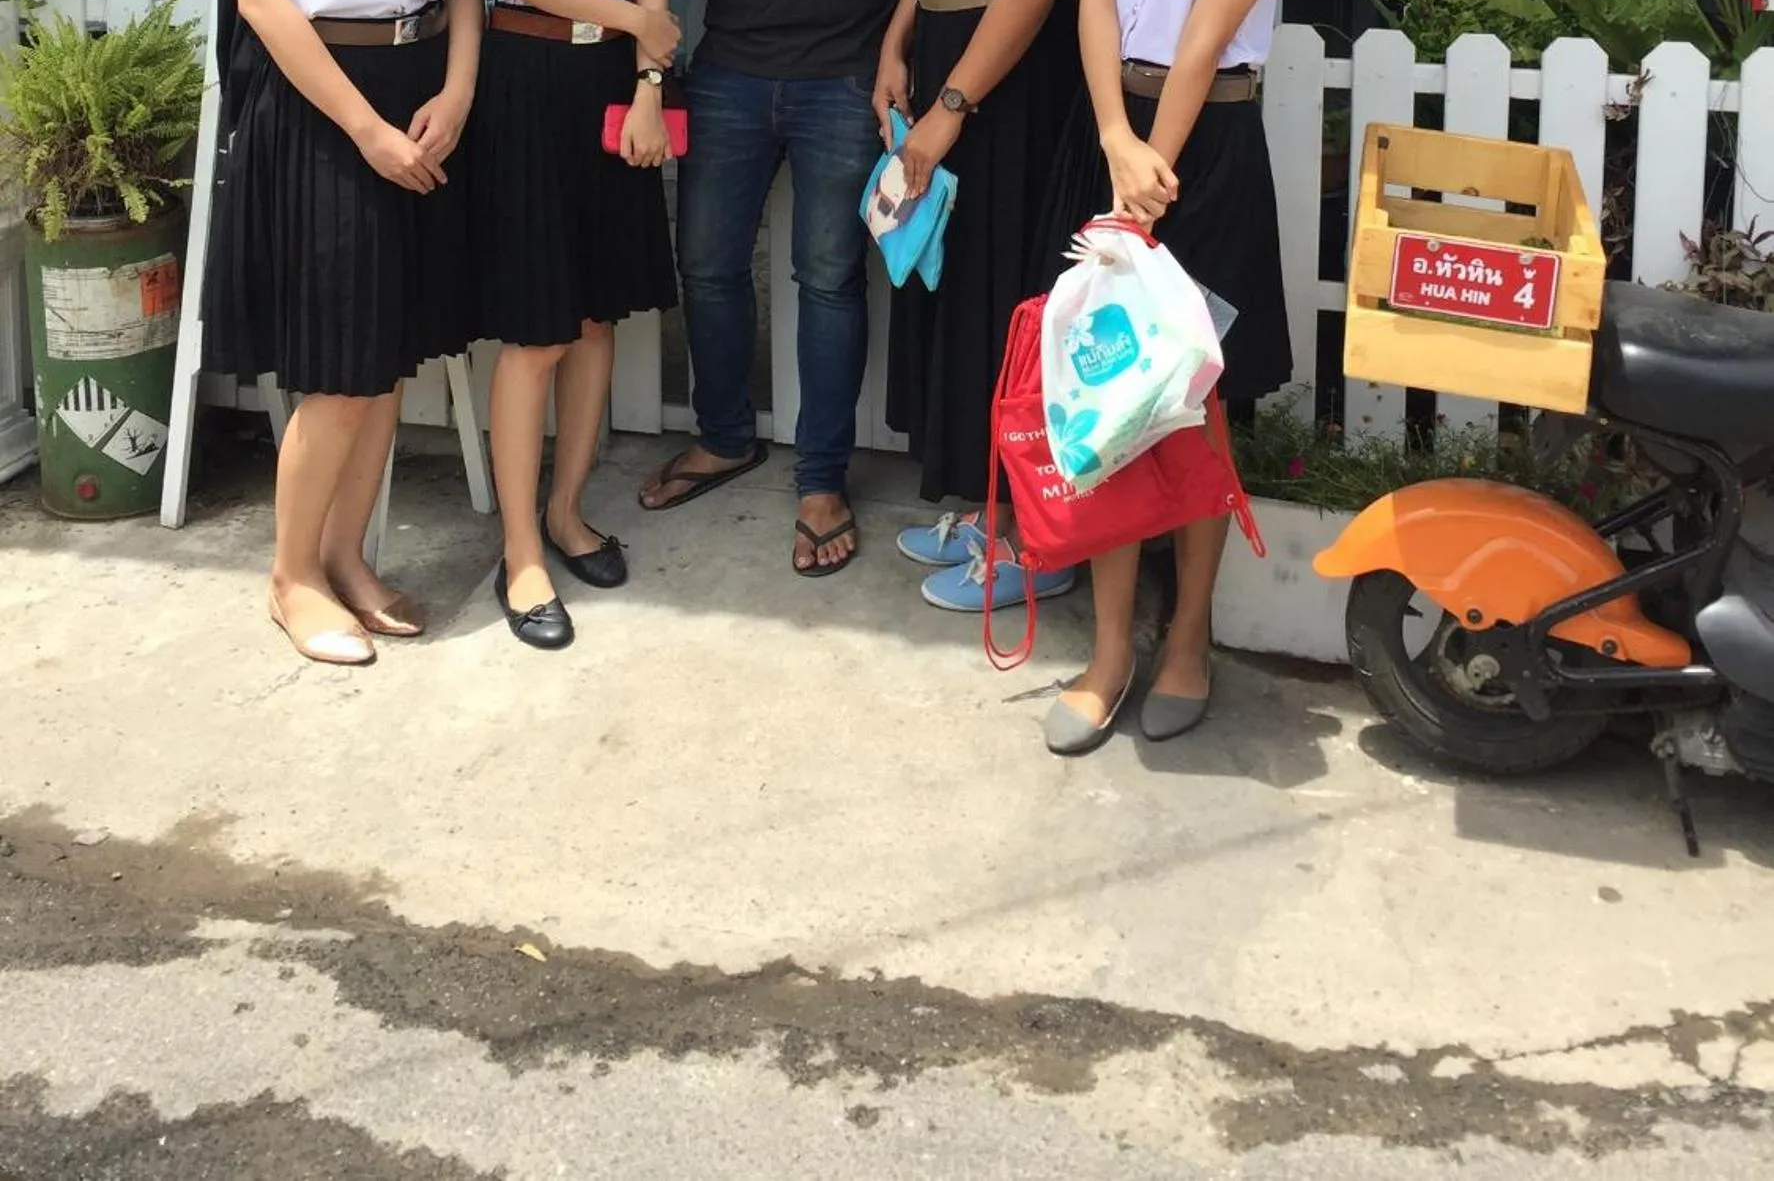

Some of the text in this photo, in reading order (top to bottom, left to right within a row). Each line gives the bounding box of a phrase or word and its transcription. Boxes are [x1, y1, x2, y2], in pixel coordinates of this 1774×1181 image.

[1412, 253, 1504, 287] อ.หัวหิน
[1420, 282, 1458, 301] HUA
[1460, 287, 1492, 306] HIN
[1513, 281, 1536, 309] 4
